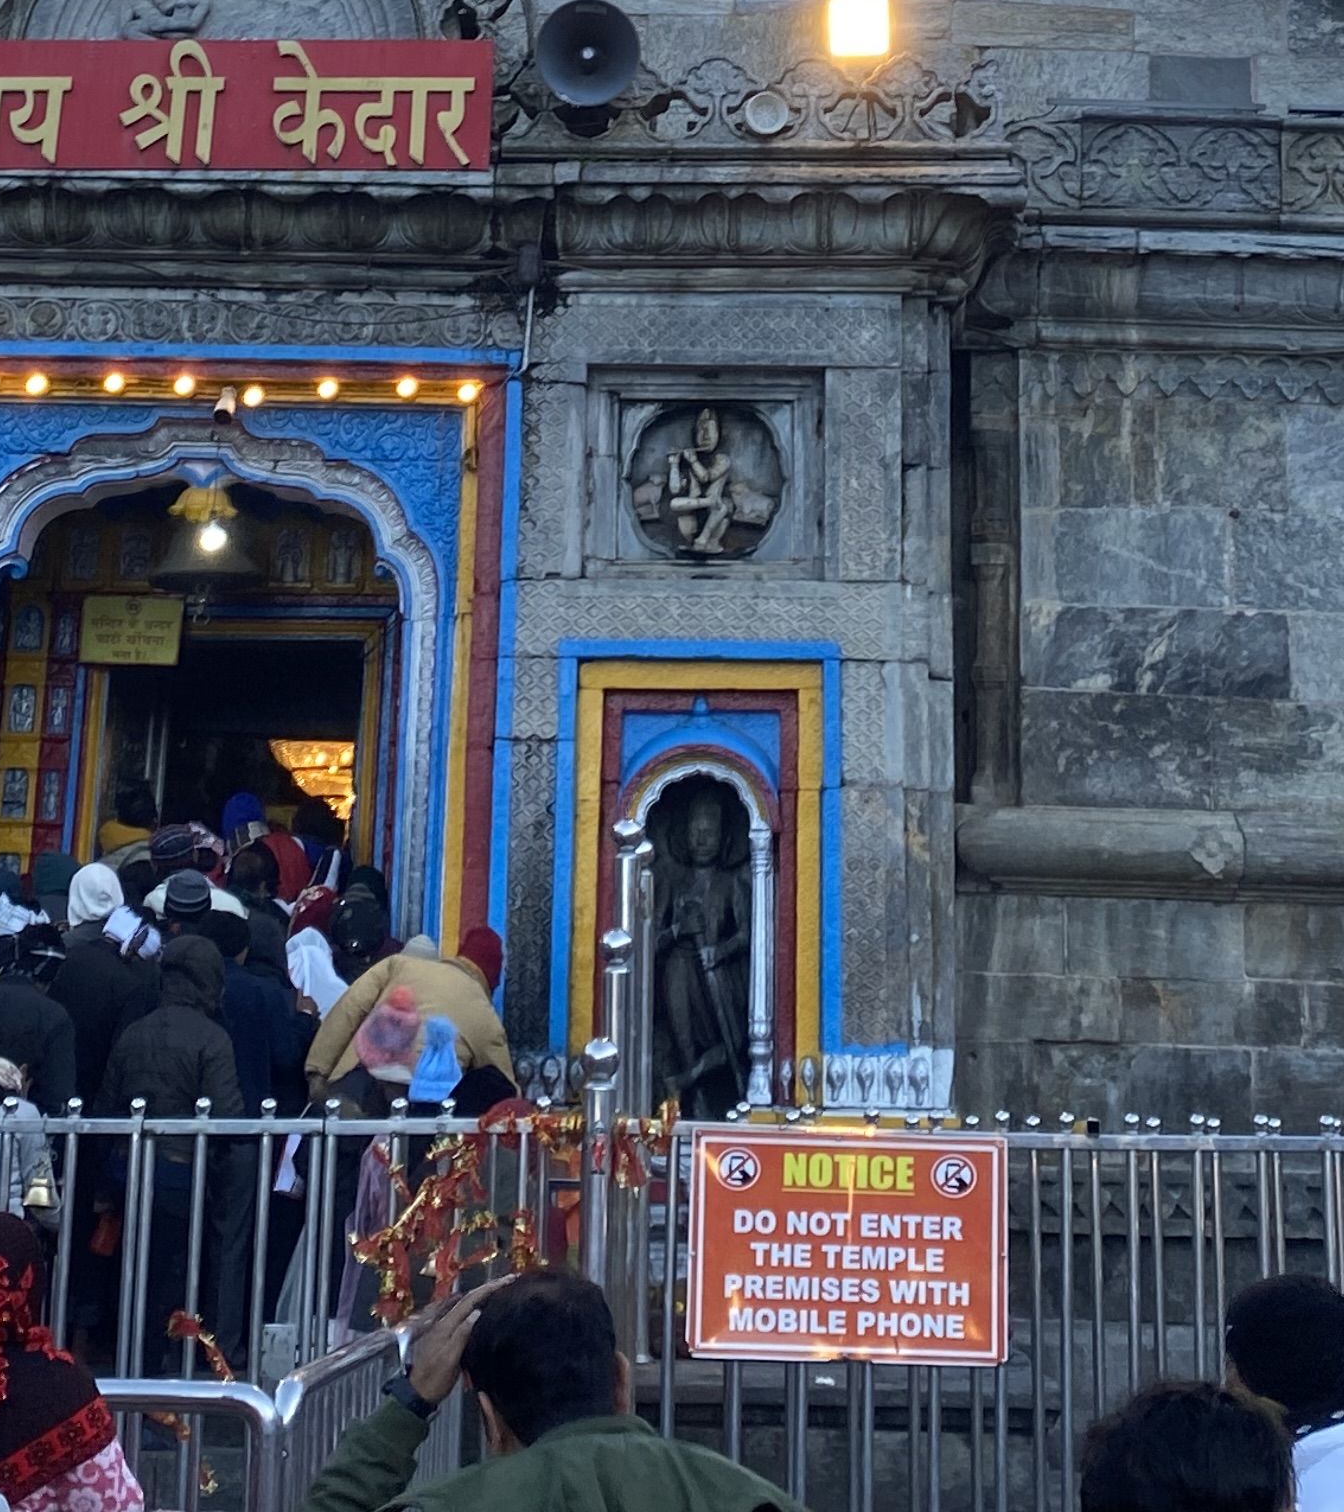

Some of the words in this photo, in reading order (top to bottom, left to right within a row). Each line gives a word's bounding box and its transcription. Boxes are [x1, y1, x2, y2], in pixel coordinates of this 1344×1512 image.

[118, 40, 225, 166] श्री
[271, 40, 476, 167] केदार
[783, 1152, 915, 1191] NOTICE
[733, 1209, 777, 1235] DO
[786, 1211, 851, 1237] NOT
[860, 1213, 963, 1241] ENTER
[750, 1242, 812, 1268] THE
[821, 1245, 945, 1273] TEMPLE
[724, 1274, 881, 1303] PREMISES
[889, 1280, 970, 1307] WITH
[728, 1307, 847, 1335] MOBILE
[857, 1312, 966, 1340] PHONE
